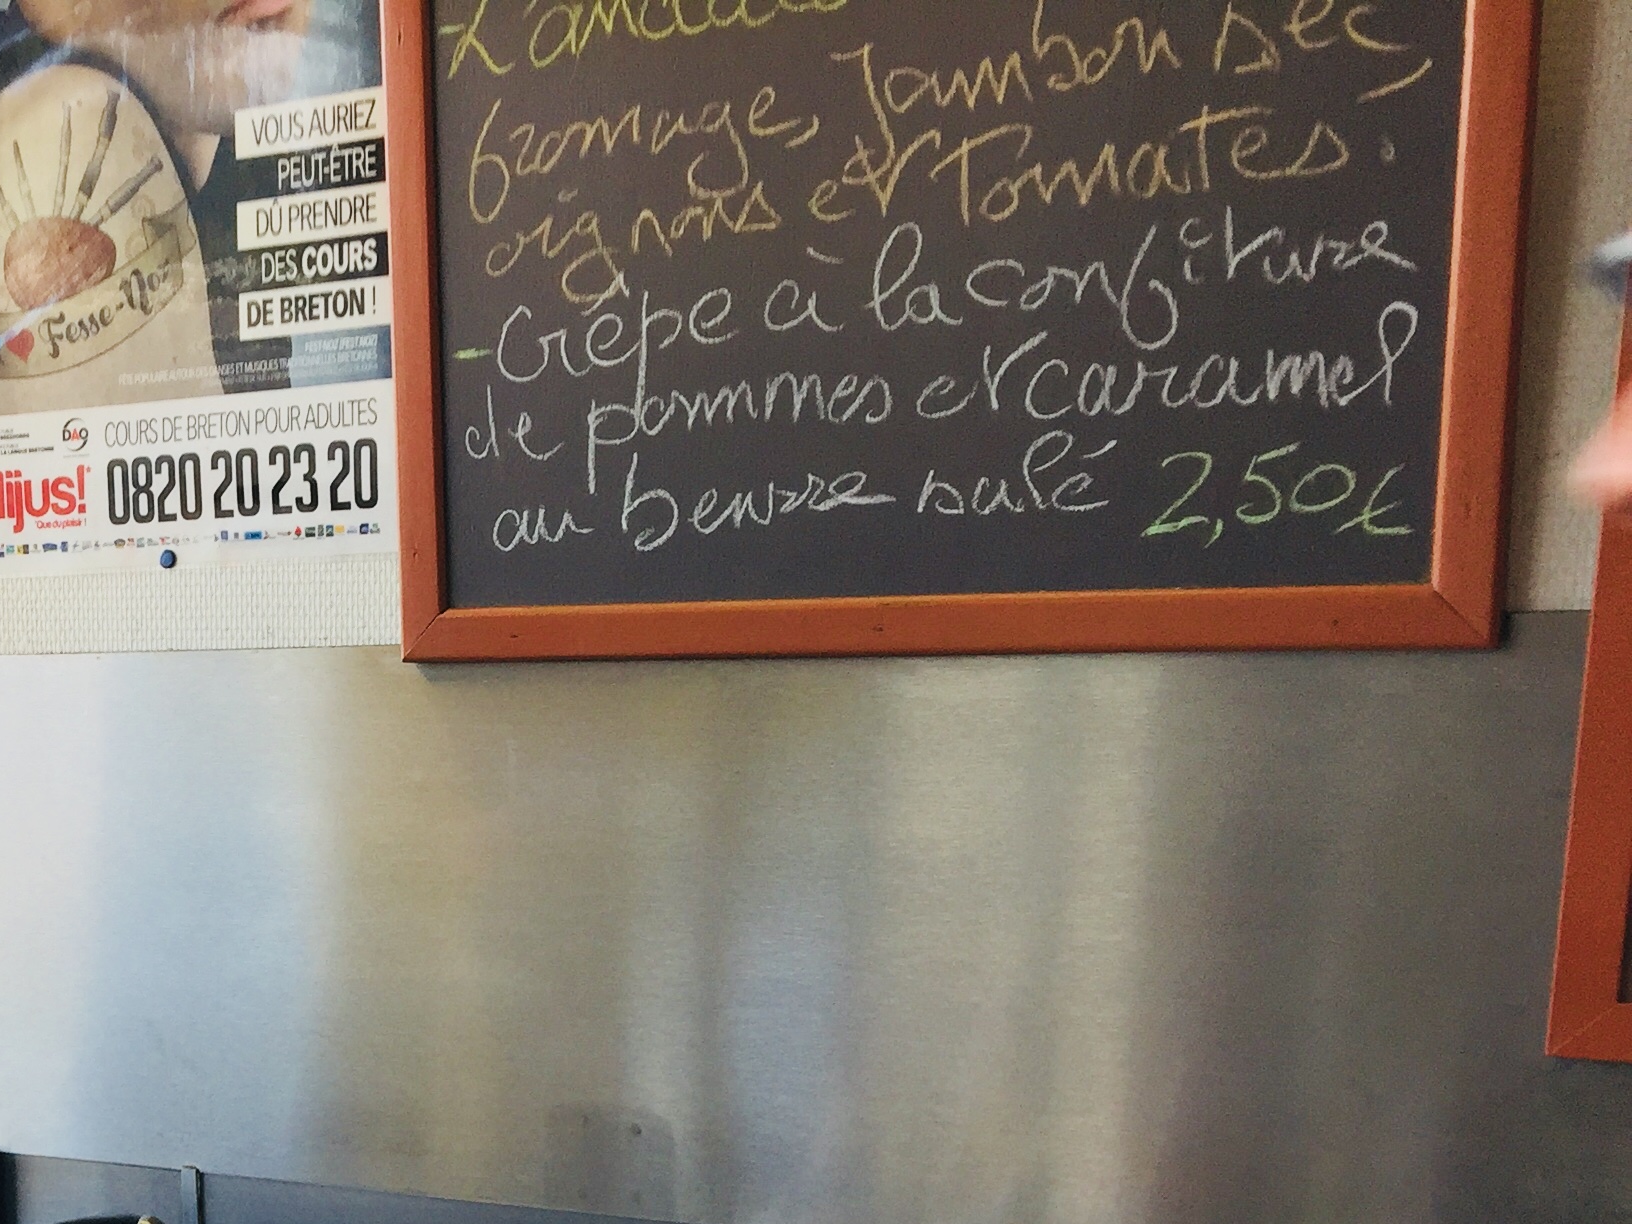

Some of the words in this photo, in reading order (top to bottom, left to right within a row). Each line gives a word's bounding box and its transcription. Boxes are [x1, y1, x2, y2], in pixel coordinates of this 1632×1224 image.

[252, 108, 305, 147] VOUS
[309, 98, 377, 139] AURIEZ
[278, 144, 378, 191] PEUT-ÊTRE
[256, 199, 282, 239] DÛ
[288, 192, 378, 234] PRENDRE
[261, 249, 298, 286] DES
[302, 237, 378, 278] COURS
[764, 245, 845, 334] à
[866, 222, 963, 332] la
[246, 299, 275, 329] DE
[280, 286, 366, 324] BRETON
[105, 416, 158, 448] COURS
[162, 415, 184, 442] DE
[187, 409, 251, 441] BRETON
[255, 404, 301, 435] POUR
[304, 397, 379, 431] ADULTES
[464, 384, 566, 460] de
[587, 370, 893, 496] pommes
[1024, 300, 1418, 420] caramel
[107, 452, 203, 526] 0820
[211, 447, 261, 519] 20
[268, 442, 319, 515] 23
[327, 437, 379, 511] 20
[492, 504, 594, 553] au
[916, 429, 1118, 517] salé
